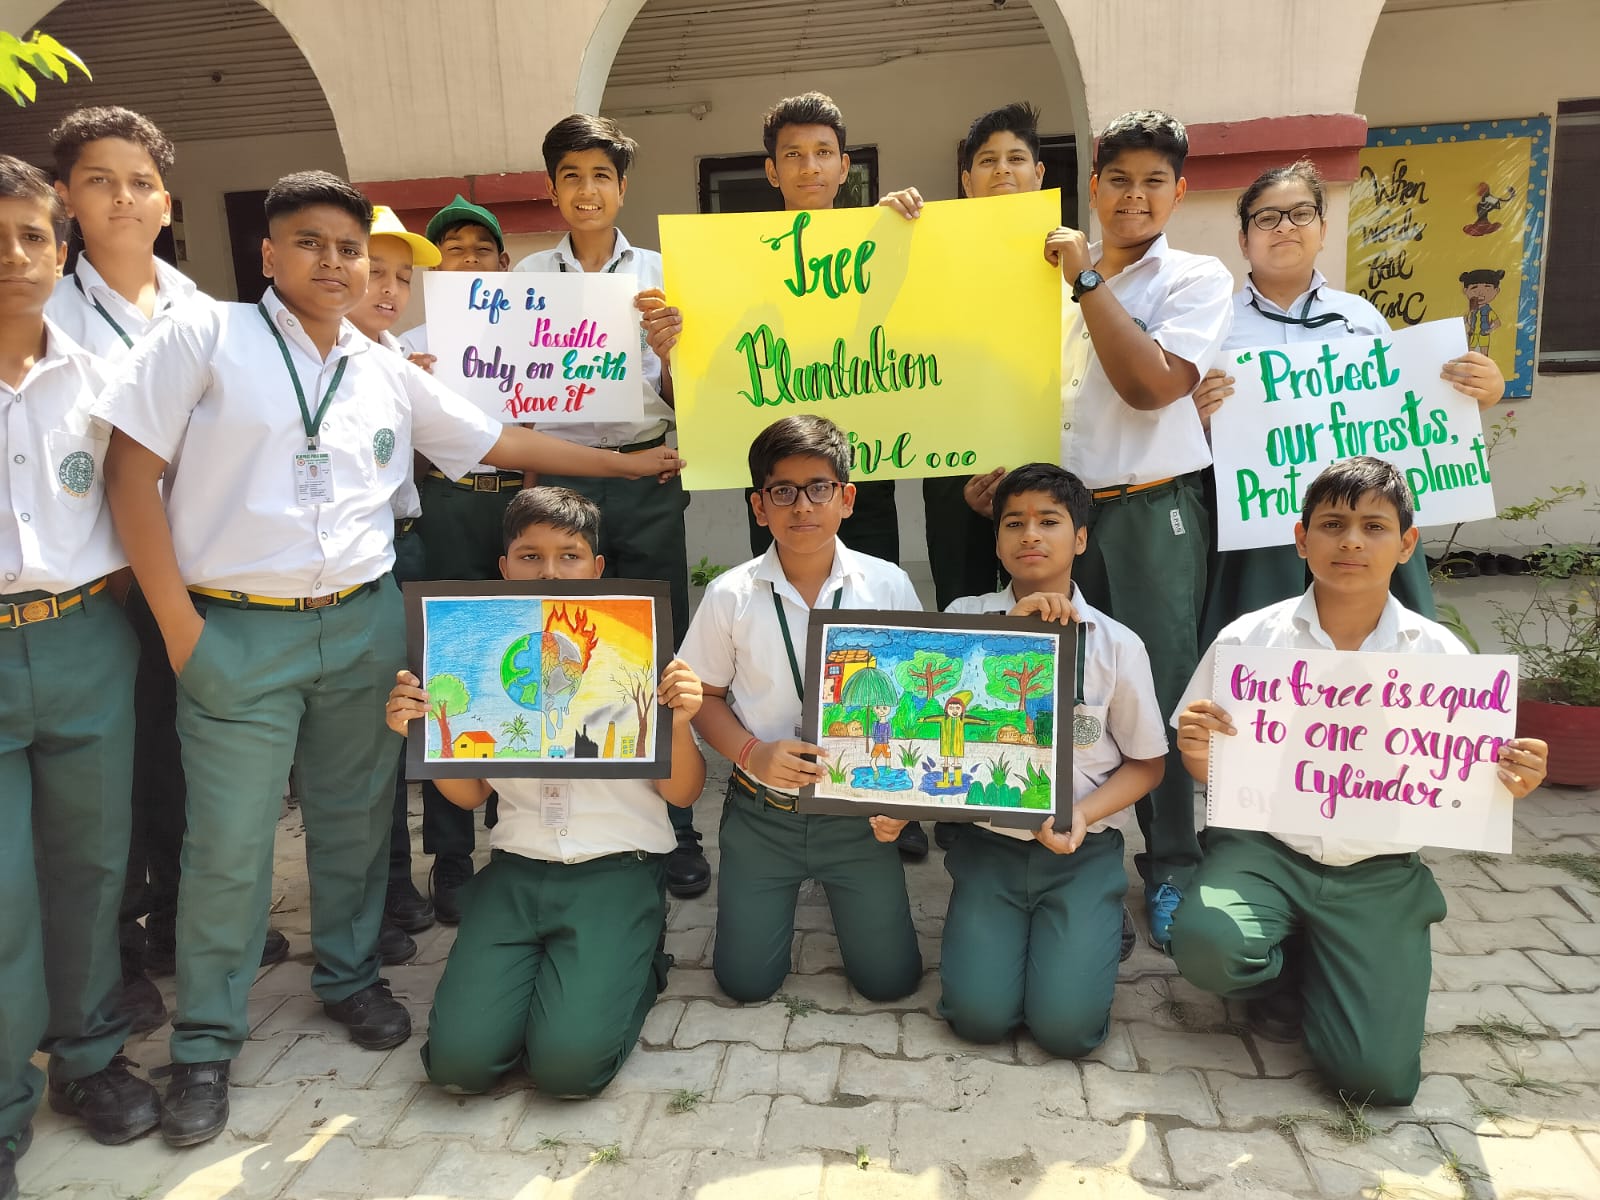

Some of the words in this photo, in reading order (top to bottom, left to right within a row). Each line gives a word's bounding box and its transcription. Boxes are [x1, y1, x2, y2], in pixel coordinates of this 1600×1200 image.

[760, 211, 876, 299] Tree
[468, 277, 511, 324] Life
[525, 287, 546, 311] is
[529, 317, 608, 348] Possible
[462, 345, 516, 392] Only
[526, 361, 554, 380] on
[562, 349, 627, 380] Earth
[735, 324, 942, 408] Plantation
[502, 382, 558, 418] Save
[562, 383, 596, 413] it
[1266, 421, 1324, 467] our
[1328, 390, 1459, 459] forests,
[1236, 465, 1312, 521] Prot
[1230, 663, 1282, 703] One
[1287, 659, 1373, 708] tree
[1380, 668, 1412, 709] is
[1418, 669, 1512, 723] equal
[1250, 708, 1287, 744] to
[1304, 721, 1368, 751] one
[1384, 726, 1512, 782] oxygen
